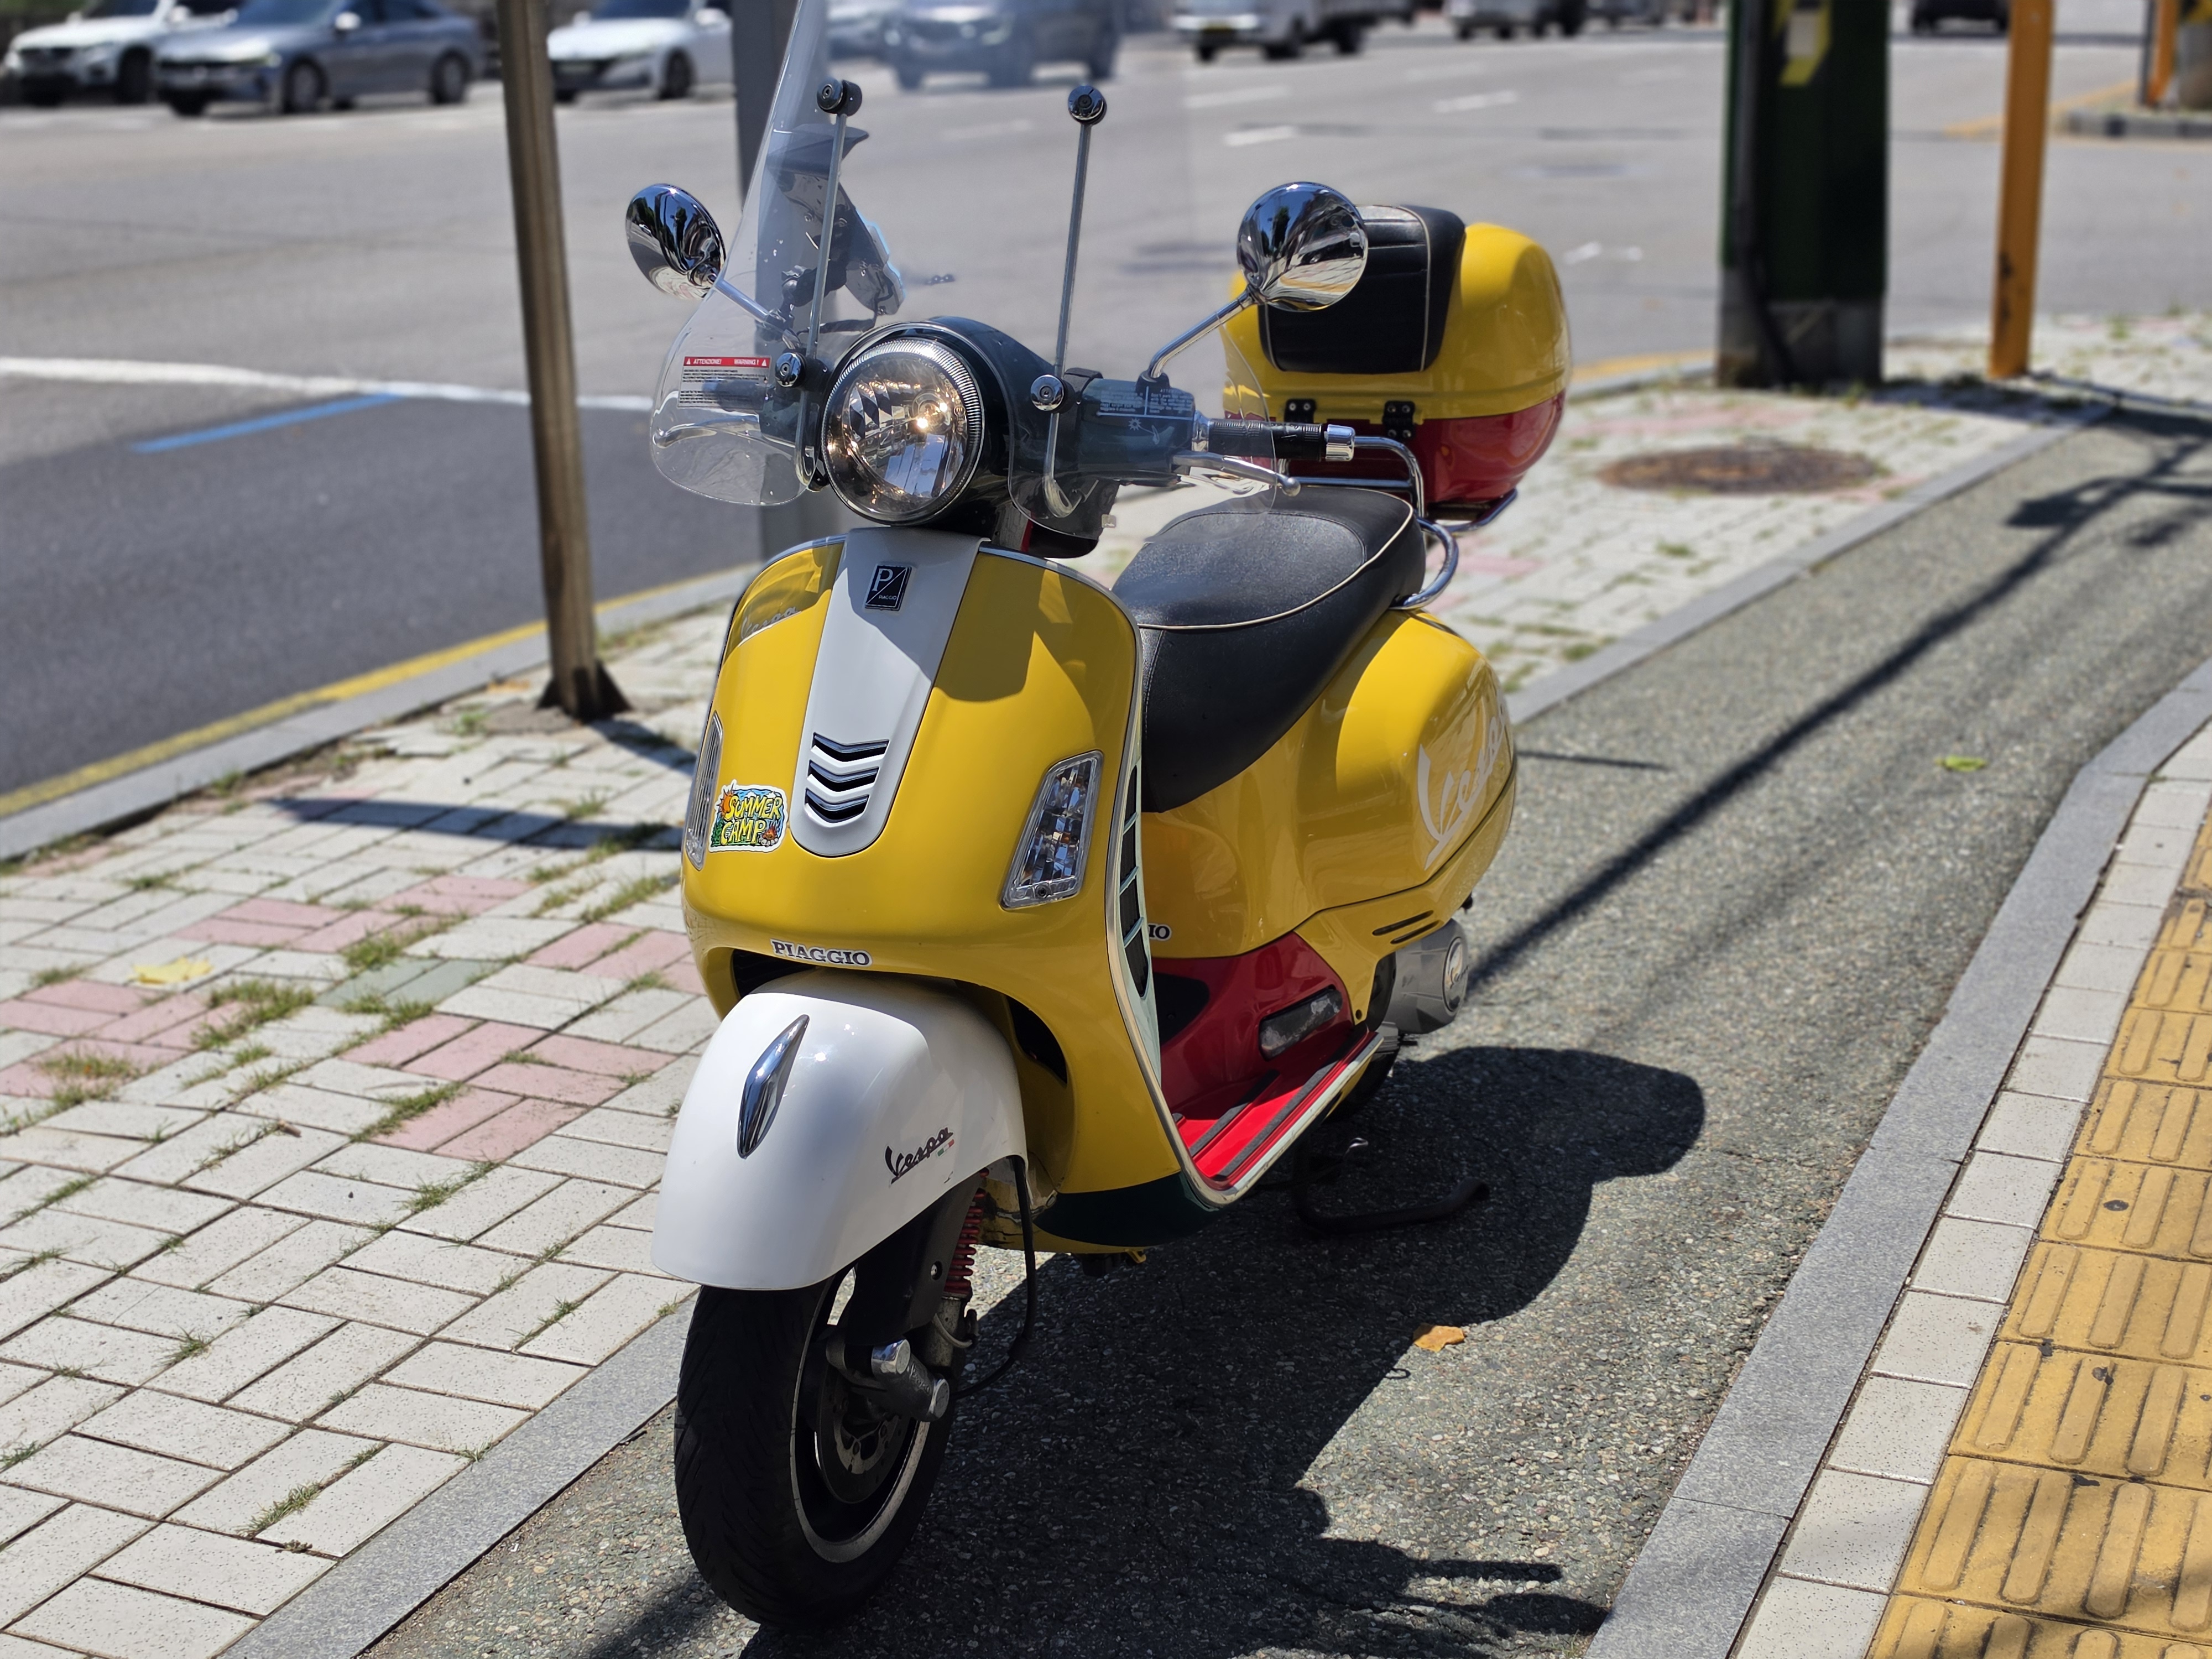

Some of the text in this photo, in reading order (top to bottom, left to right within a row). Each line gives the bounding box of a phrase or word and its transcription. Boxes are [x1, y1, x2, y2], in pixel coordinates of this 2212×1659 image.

[872, 568, 893, 591] P
[738, 606, 802, 648] Vespa
[724, 795, 782, 821] SUMMER
[721, 818, 766, 845] CAMP
[1148, 924, 1170, 939] IO
[772, 941, 870, 966] PIAGGIO
[885, 1126, 953, 1185] Vespa
